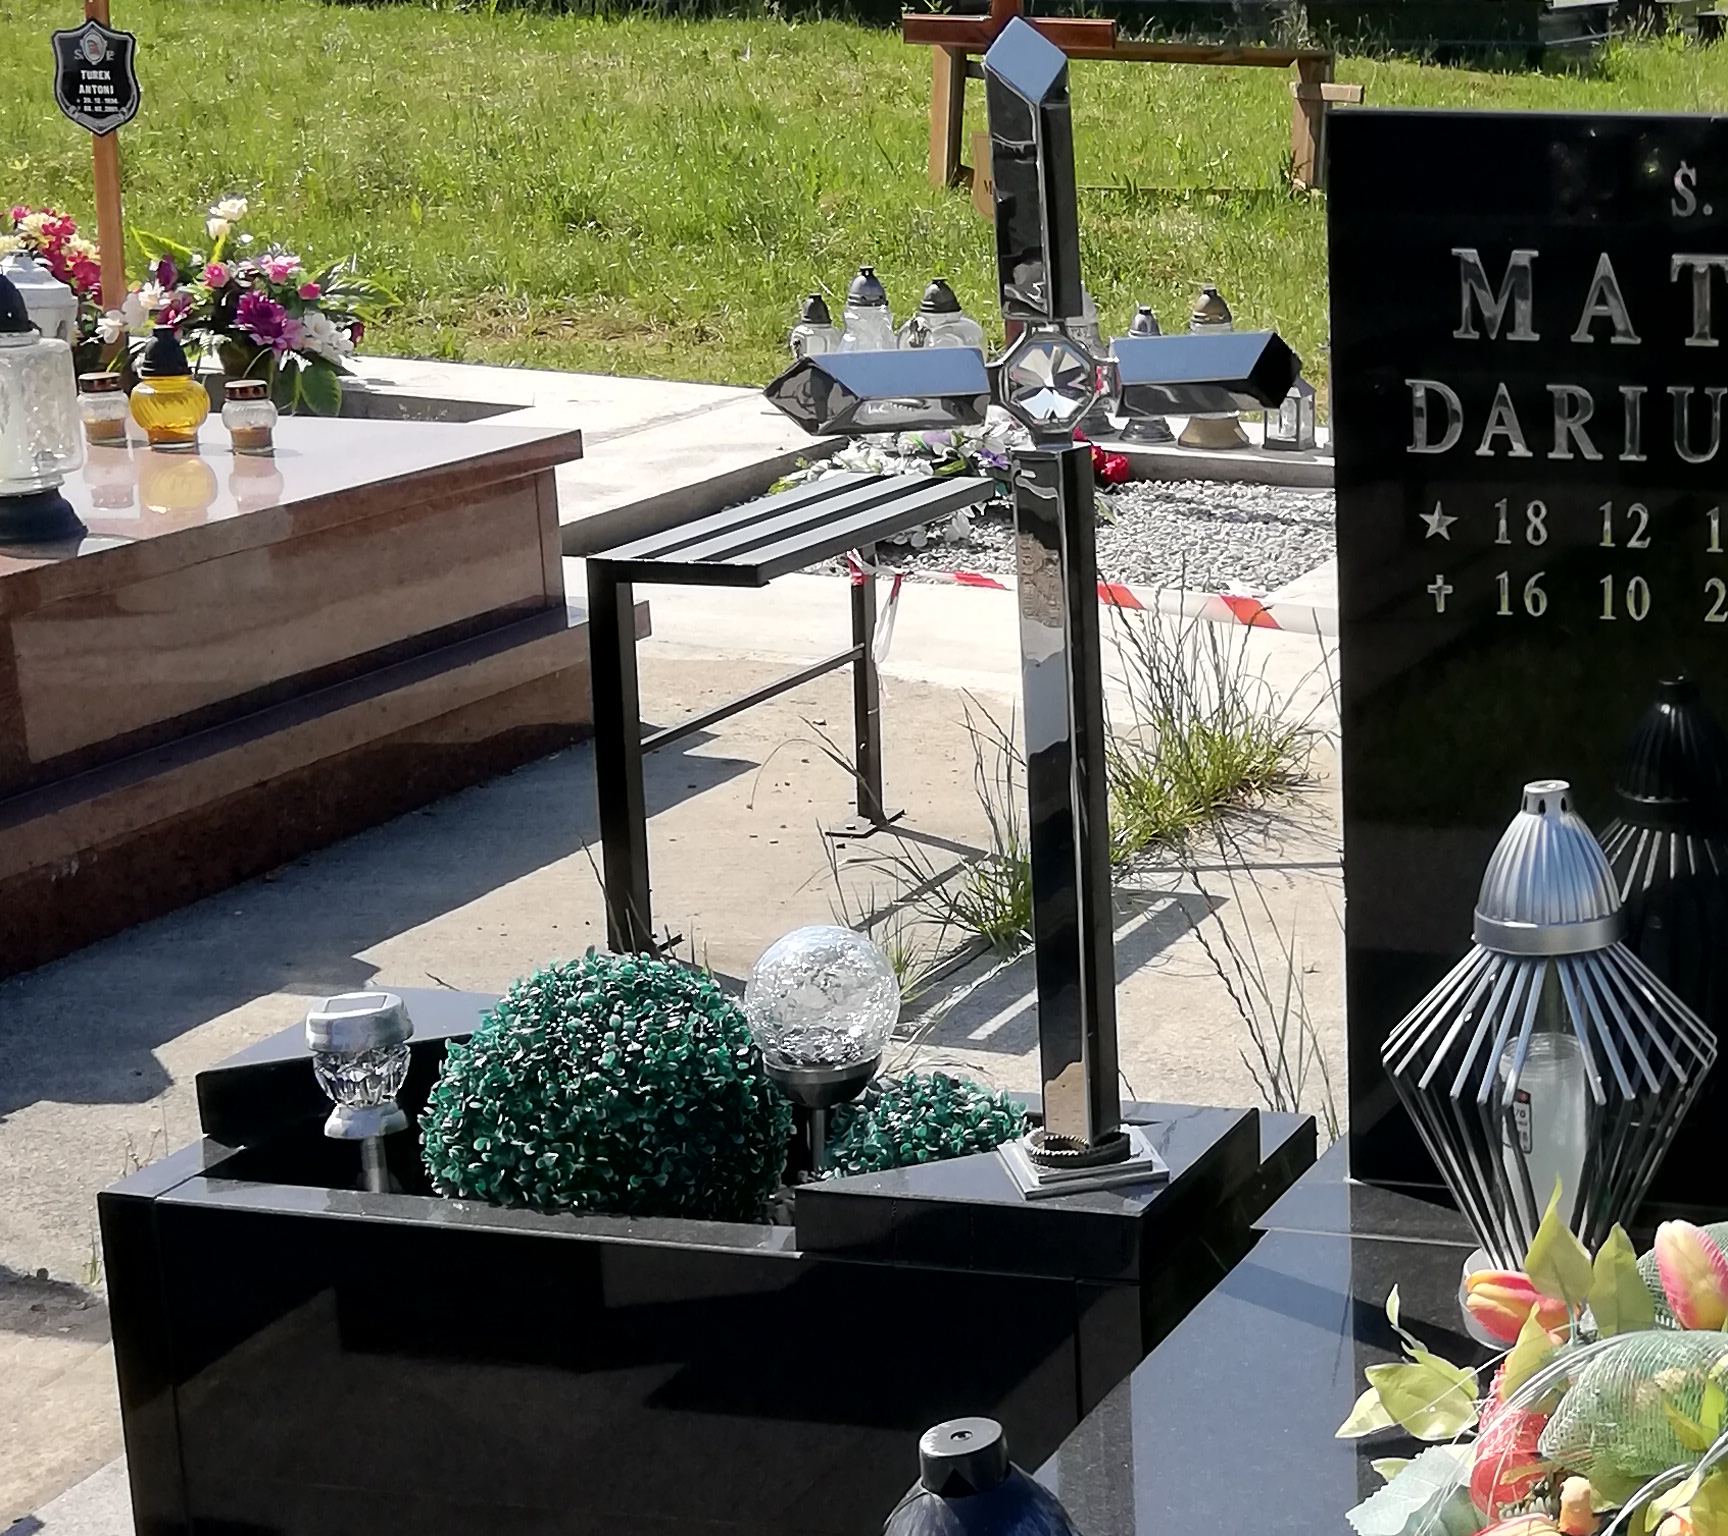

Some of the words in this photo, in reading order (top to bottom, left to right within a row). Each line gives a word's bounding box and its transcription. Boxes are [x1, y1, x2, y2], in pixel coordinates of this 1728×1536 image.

[1494, 498, 1548, 547] 18
[1599, 501, 1650, 549] 12
[1495, 571, 1548, 617] 16
[1599, 574, 1650, 622] 10
